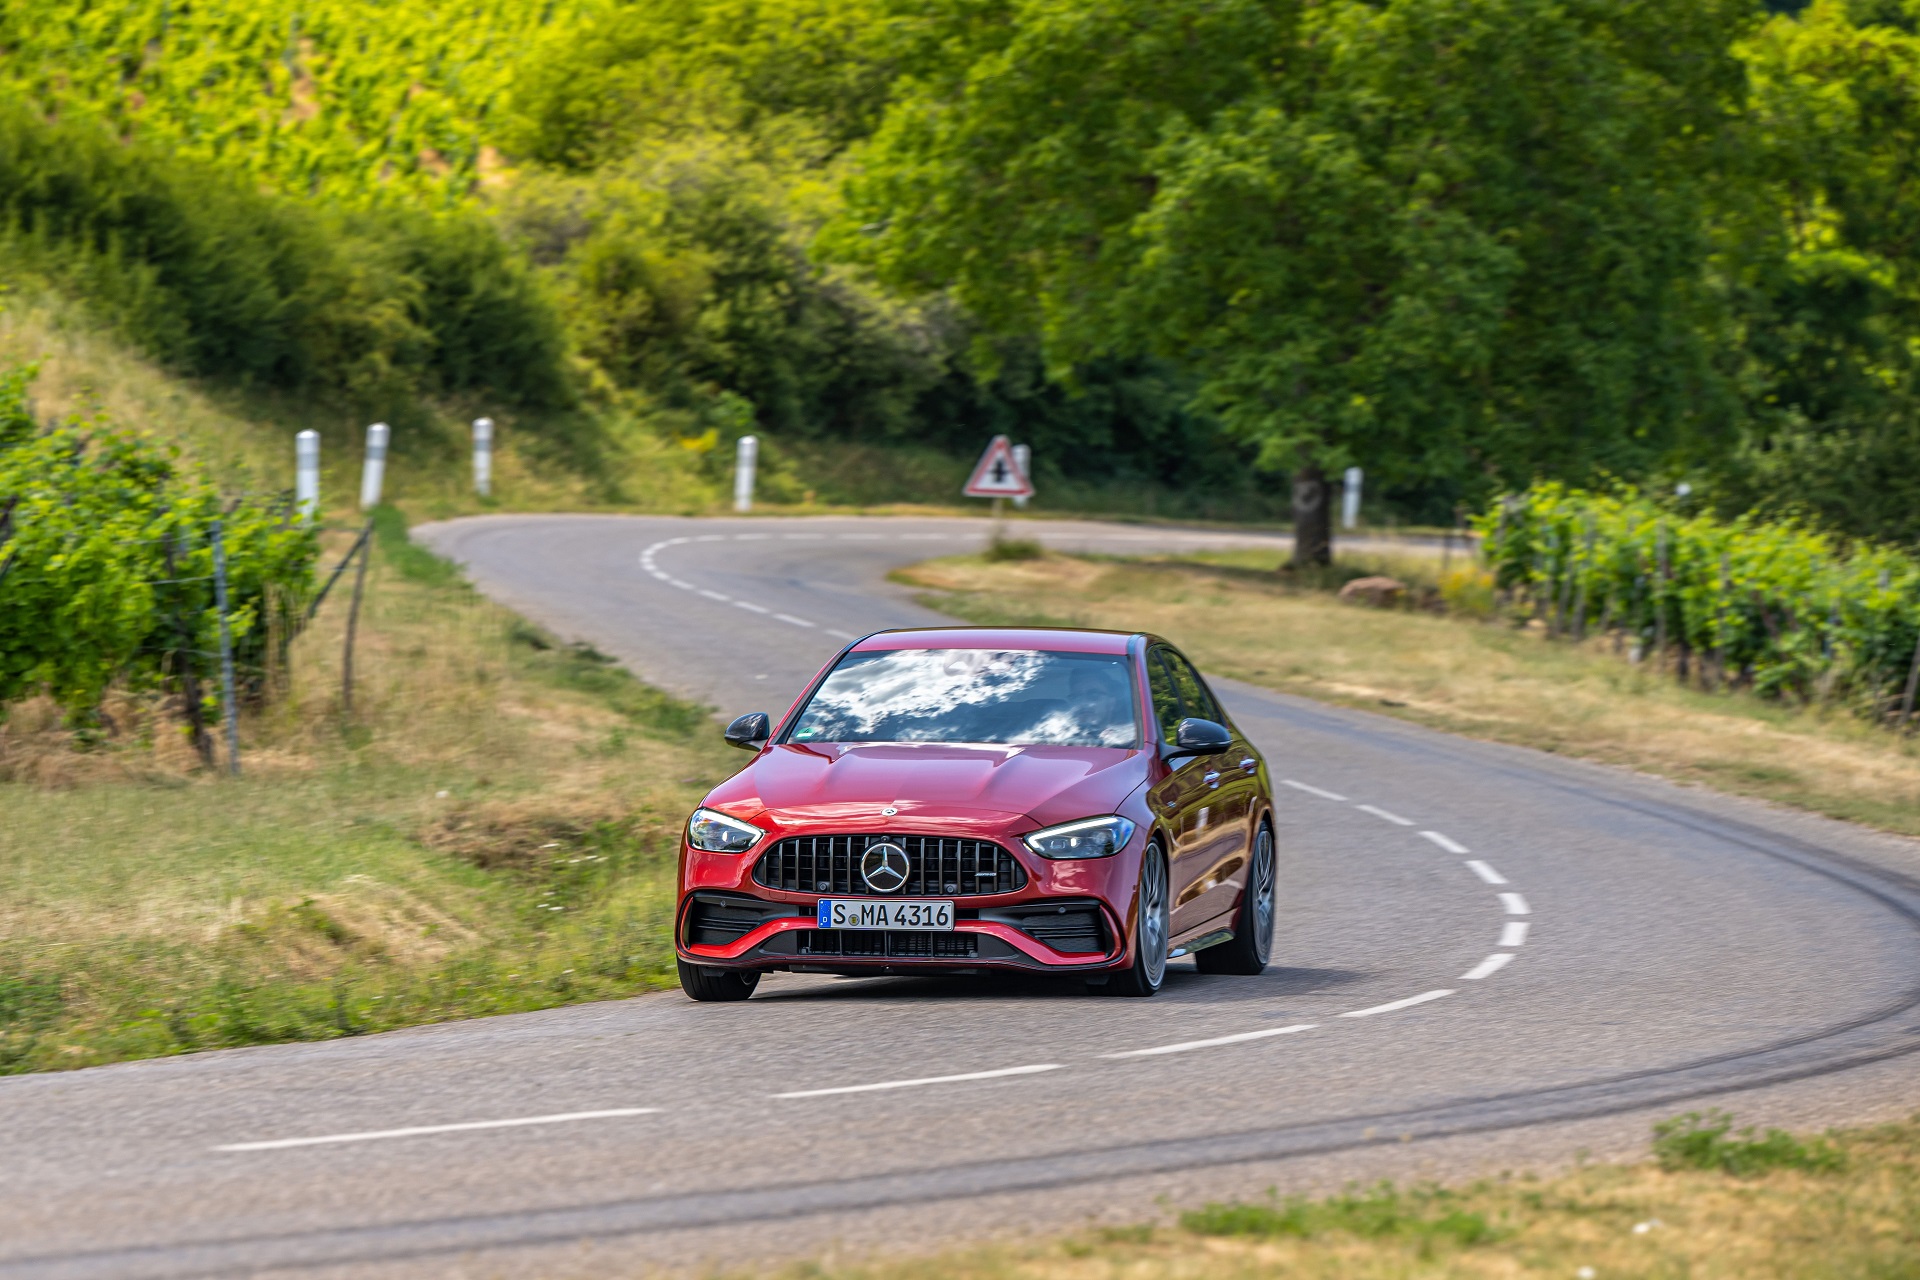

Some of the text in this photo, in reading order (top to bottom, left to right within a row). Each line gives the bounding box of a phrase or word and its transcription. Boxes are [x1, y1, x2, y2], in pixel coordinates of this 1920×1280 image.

[833, 904, 949, 926] S MA 4316
